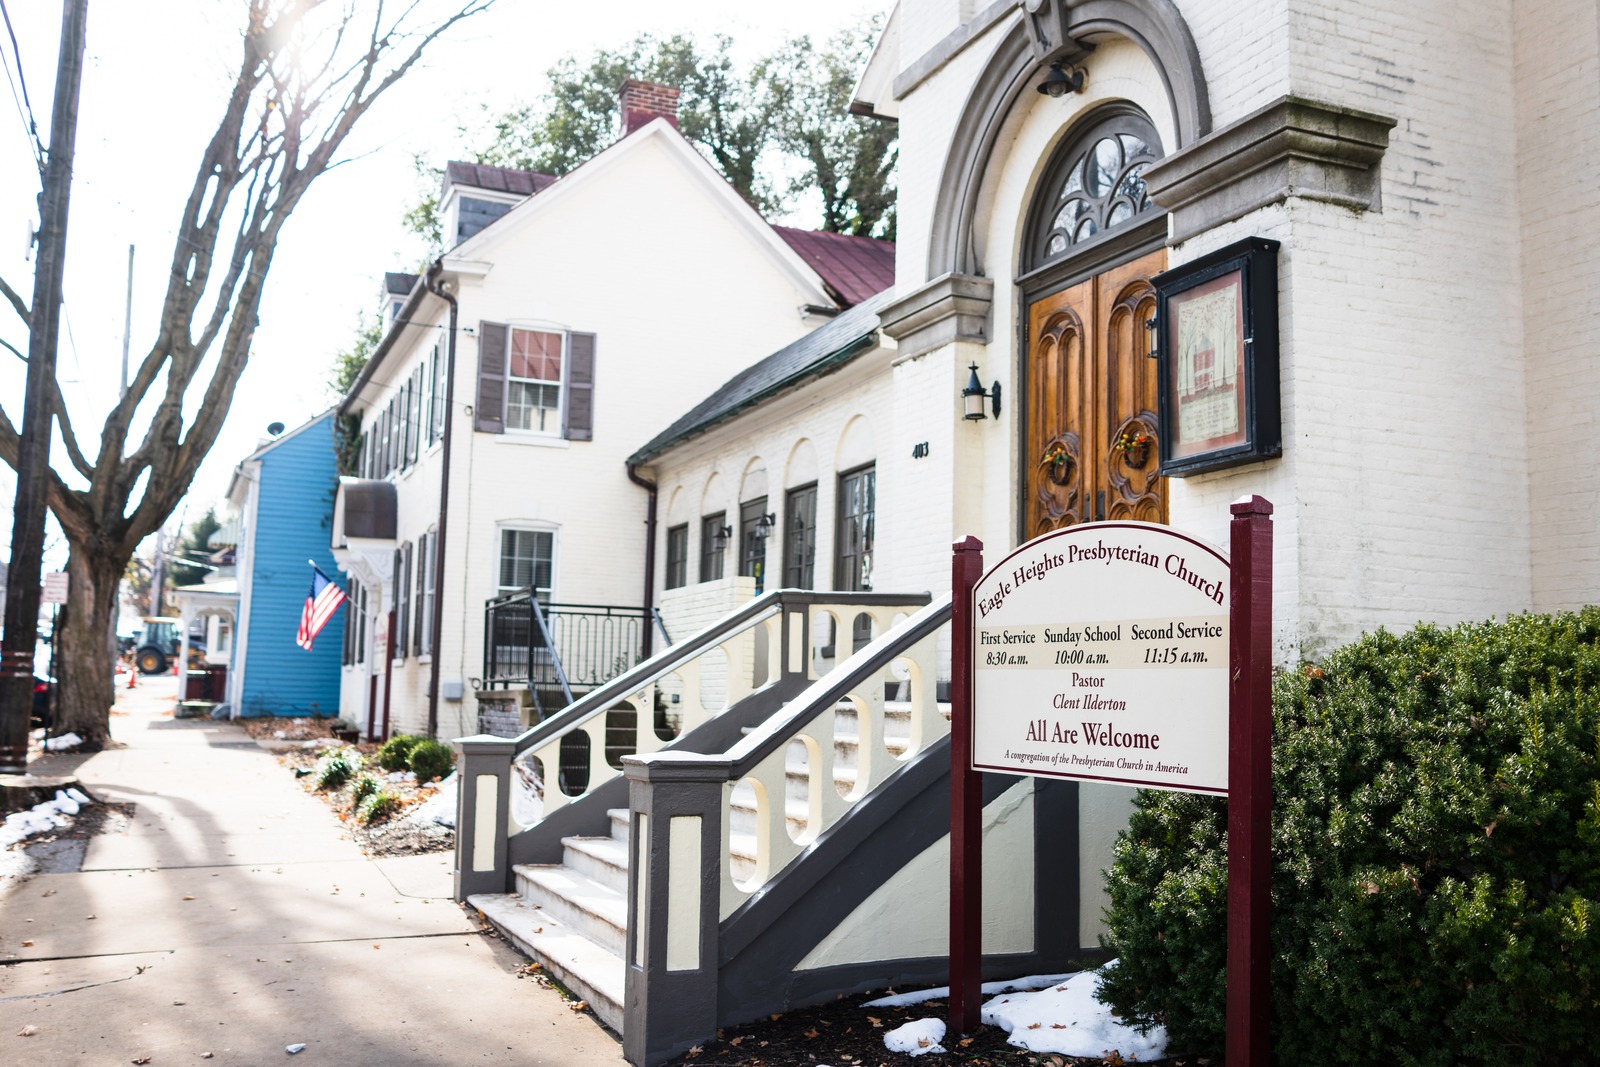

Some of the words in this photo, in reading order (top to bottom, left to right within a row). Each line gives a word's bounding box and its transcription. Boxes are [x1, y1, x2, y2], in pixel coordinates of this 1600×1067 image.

[912, 441, 929, 459] 403
[978, 582, 1012, 619] Eagle
[1012, 553, 1064, 588] Heights
[1068, 540, 1159, 568] Presbyterian
[1165, 554, 1224, 606] Church
[981, 631, 1001, 645] First
[1003, 630, 1036, 644] Service
[1044, 627, 1081, 647] Sunday
[1084, 625, 1121, 641] School
[1131, 622, 1174, 640] Second
[1177, 622, 1222, 639] Service
[986, 651, 1007, 665] 8:30
[1008, 654, 1029, 665] a.m.
[1055, 649, 1084, 664] 10:00
[1086, 653, 1109, 664] a.m.
[1144, 647, 1178, 664] 11:15
[1181, 650, 1208, 663] a.m.
[1072, 672, 1105, 688] Pastor
[1053, 693, 1080, 710] Clent
[1083, 694, 1127, 711] Ilderton
[1026, 719, 1047, 742] All
[1051, 721, 1078, 744] Are
[1081, 722, 1160, 750] Welcome
[1004, 749, 1010, 759] A
[1010, 752, 1050, 763] congregation
[1051, 752, 1058, 766] of
[1059, 755, 1069, 764] the
[1071, 755, 1115, 769] Presbyterian
[1117, 757, 1144, 771] Church
[1145, 760, 1153, 771] in
[1155, 761, 1188, 775] America
